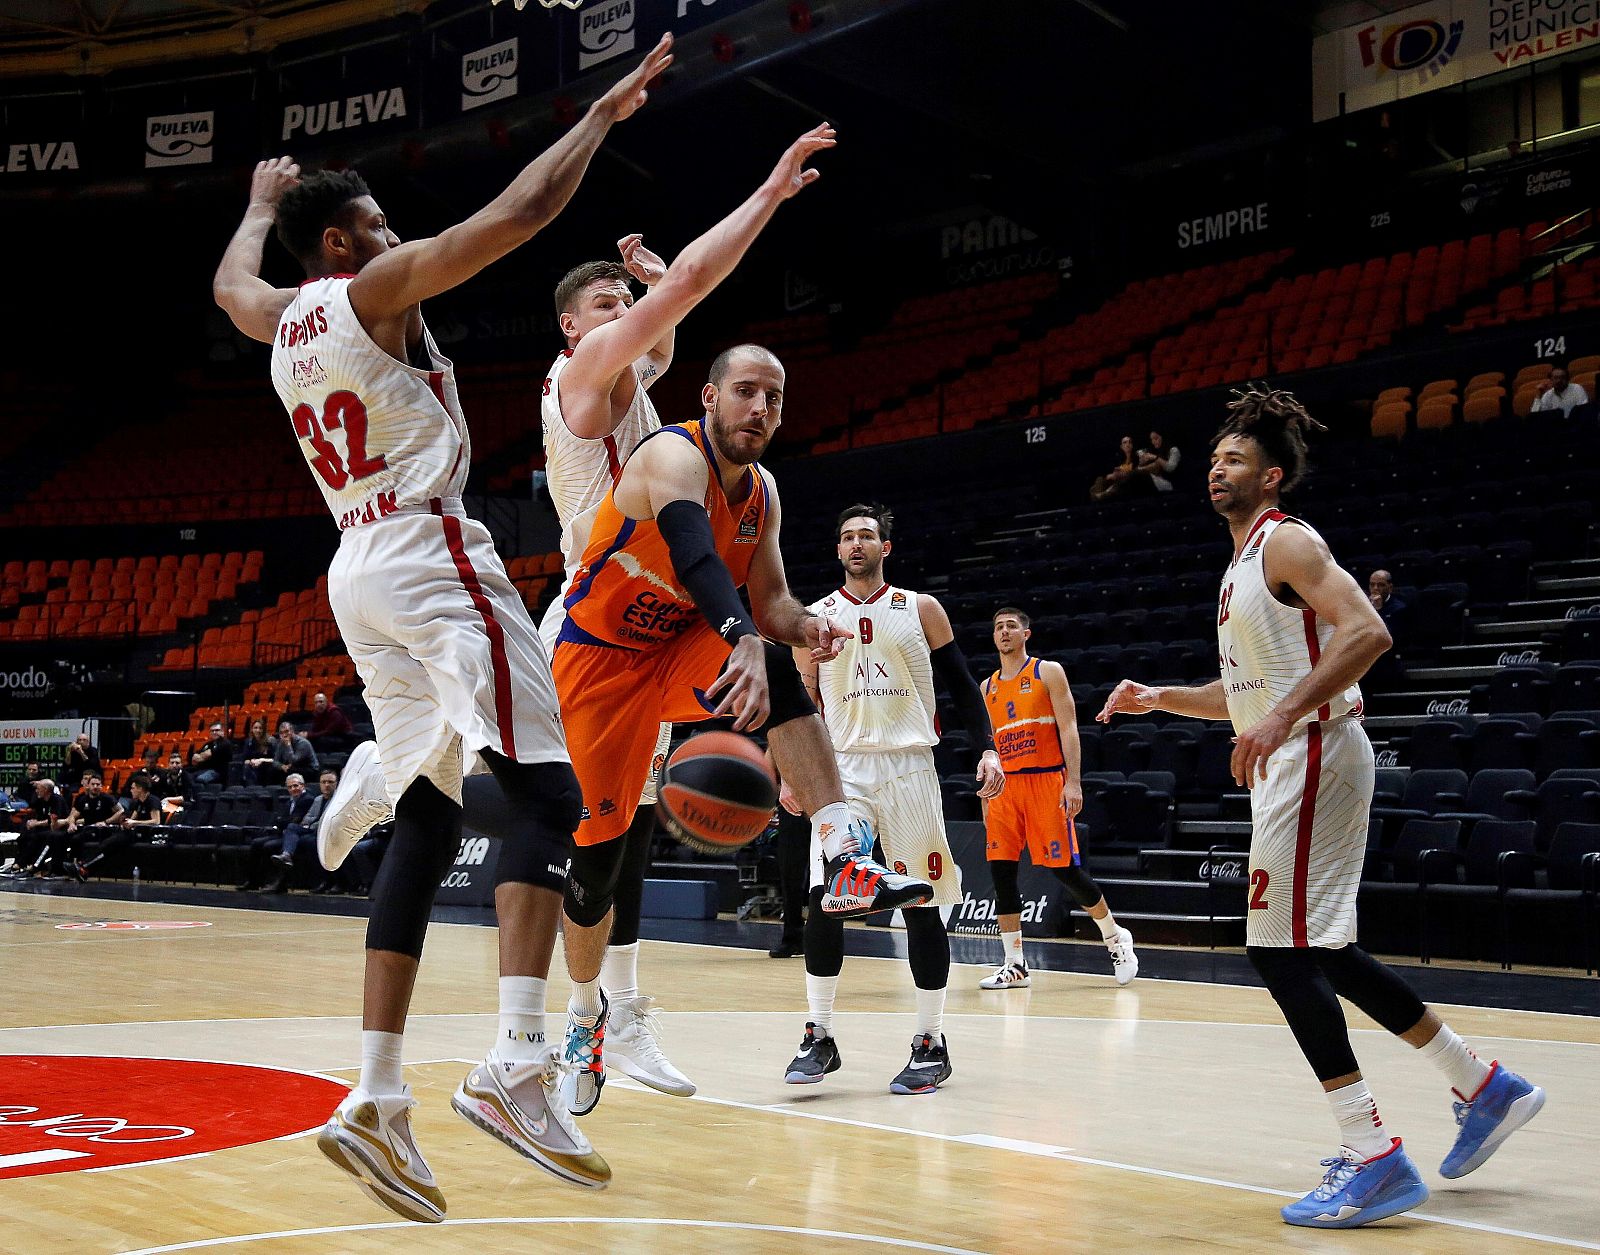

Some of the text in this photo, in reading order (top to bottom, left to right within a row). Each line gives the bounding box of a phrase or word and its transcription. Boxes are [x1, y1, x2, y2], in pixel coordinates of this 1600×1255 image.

[582, 3, 633, 35] PULEVA
[1490, 0, 1578, 28] DEPO
[465, 48, 514, 77] PULEVA
[282, 87, 407, 141] PULEVA
[151, 120, 209, 137] PULEVA
[0, 142, 79, 172] EVA
[1178, 203, 1268, 248] SEMPRE
[1371, 212, 1390, 228] 225
[1534, 336, 1567, 358] 124
[292, 390, 388, 491] 32
[1025, 427, 1046, 443] 125
[179, 528, 197, 541] 102
[859, 617, 874, 644] 9
[866, 688, 910, 697] EXCHANGE
[1005, 701, 1017, 719] 2
[1050, 840, 1062, 859] 2
[928, 851, 943, 880] 9
